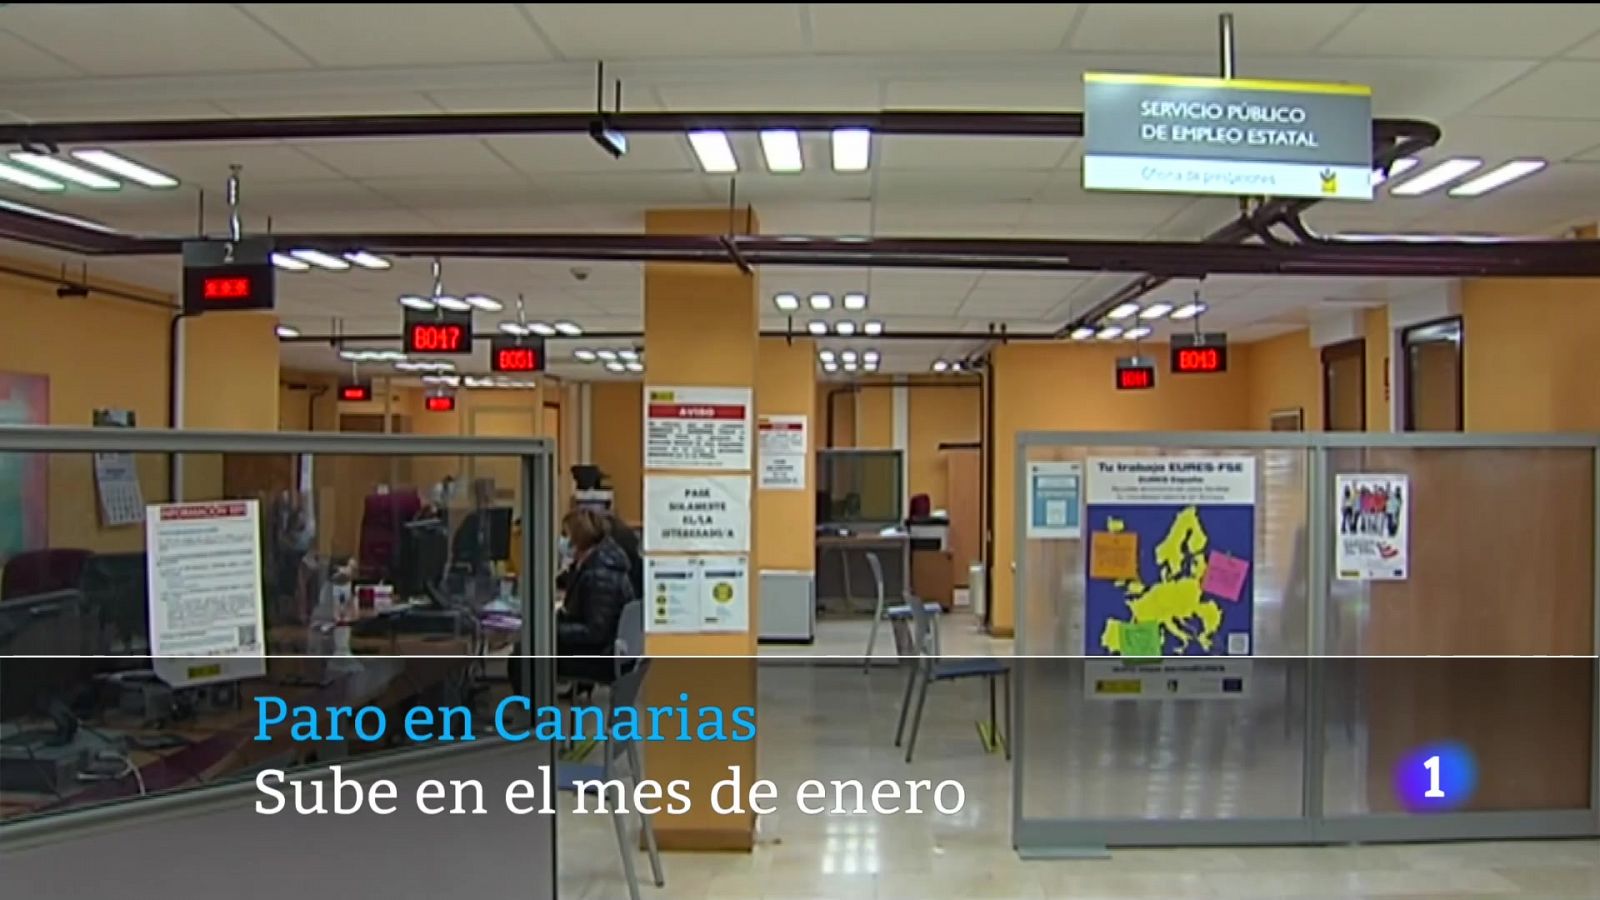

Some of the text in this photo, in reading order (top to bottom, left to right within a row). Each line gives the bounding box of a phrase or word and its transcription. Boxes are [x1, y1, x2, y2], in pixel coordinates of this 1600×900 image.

[1140, 101, 1306, 123] SERVICIO PÚBLICO
[1141, 124, 1319, 147] DE EMPLEO ESTATAL
[224, 241, 235, 264] 2
[1098, 462, 1114, 472] Tu
[1117, 461, 1165, 474] trabajo
